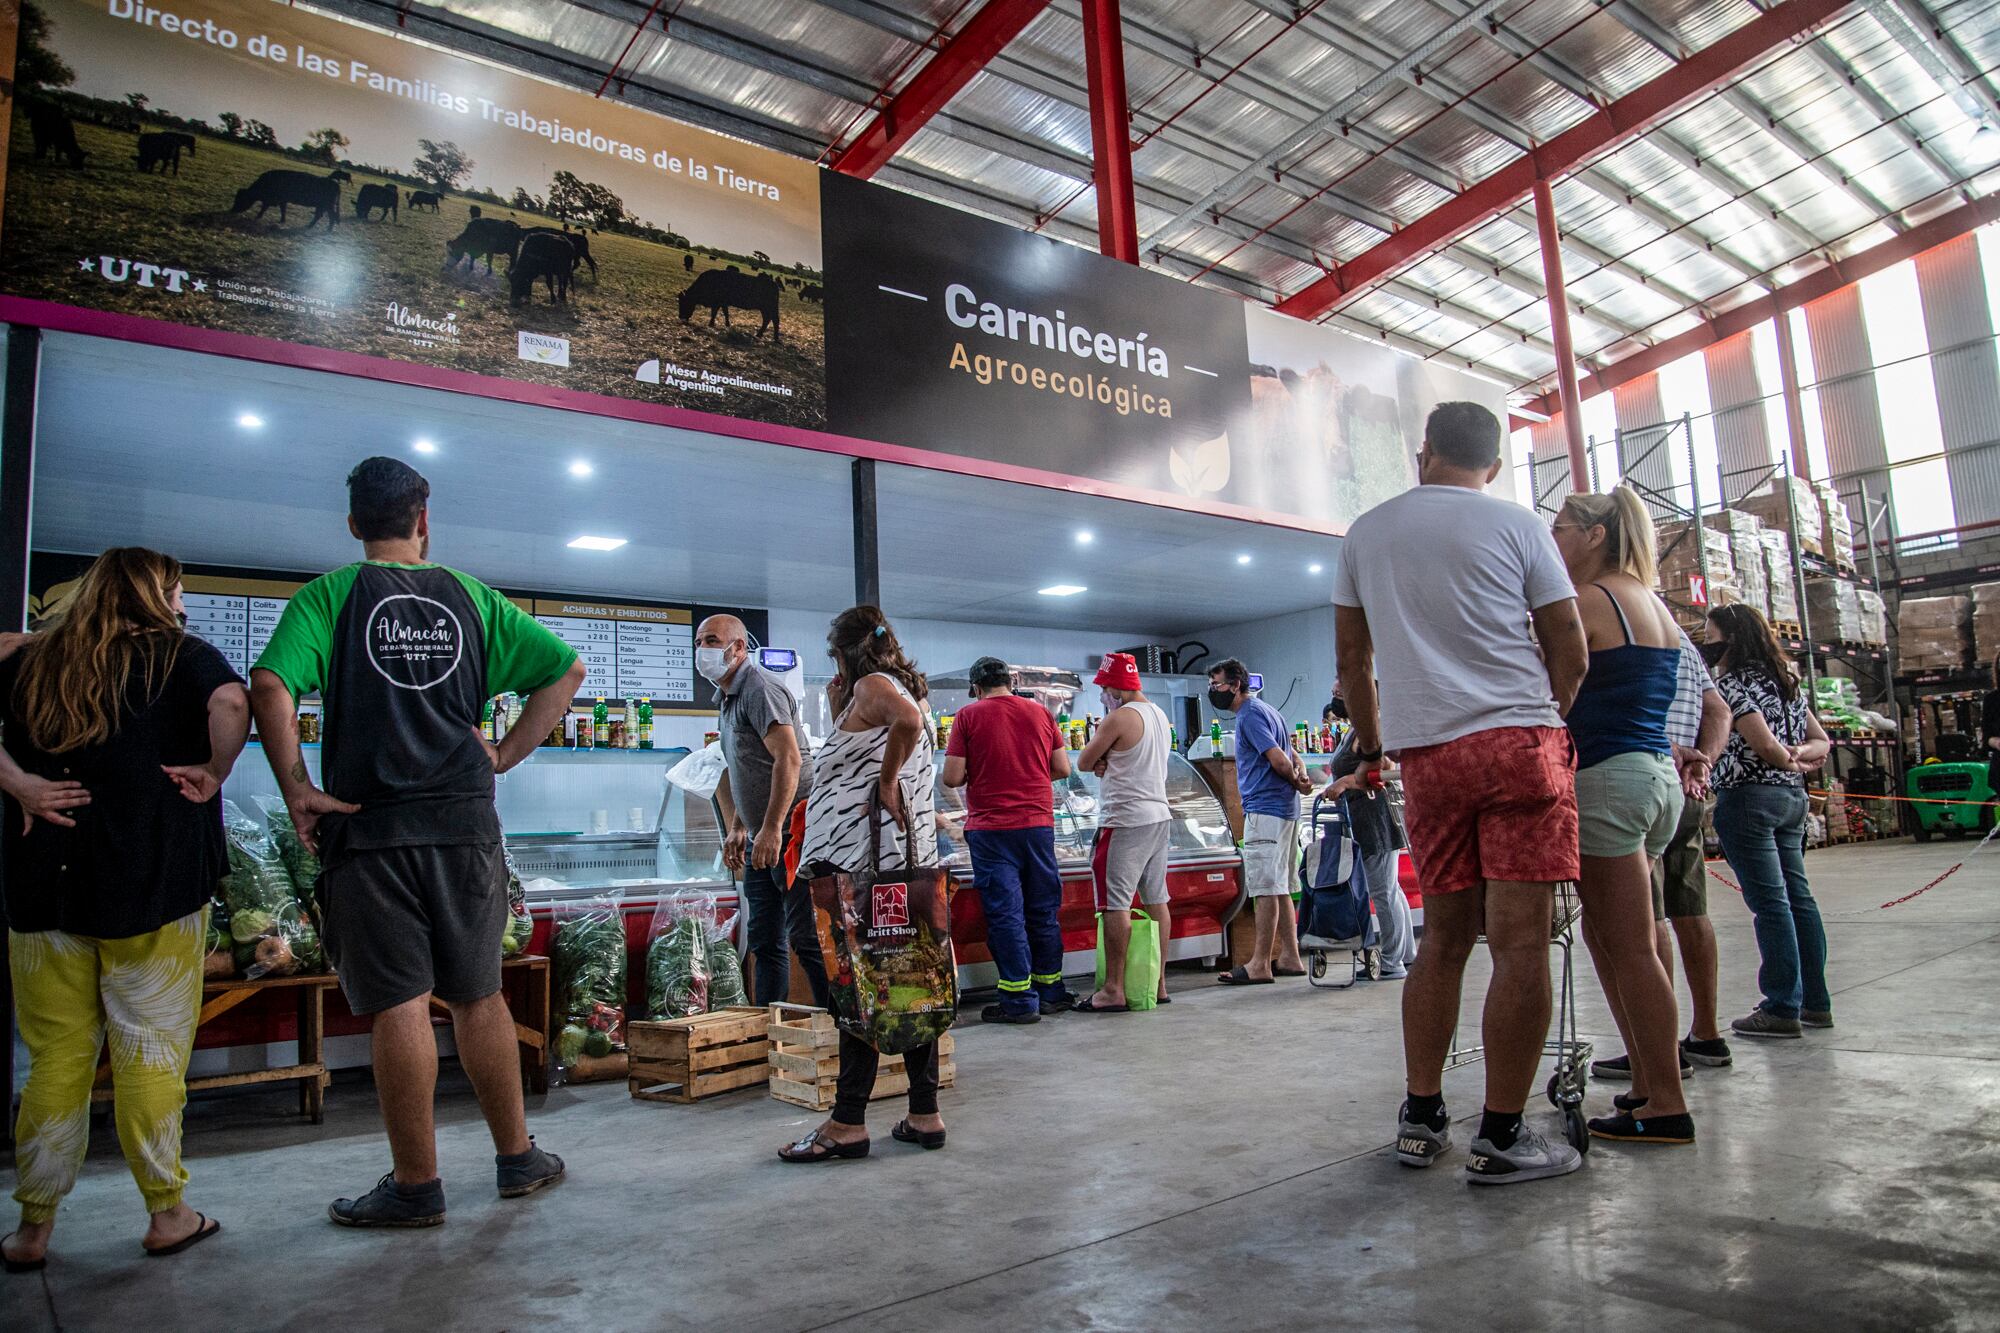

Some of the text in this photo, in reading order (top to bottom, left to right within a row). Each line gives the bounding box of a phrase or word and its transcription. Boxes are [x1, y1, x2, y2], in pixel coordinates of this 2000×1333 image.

[109, 0, 780, 201] Directo de las Familias Trabajadoras de la Tierra
[99, 255, 190, 293] UTT
[217, 279, 247, 291] Unión
[249, 285, 262, 295] de
[266, 287, 327, 307] Trabajadores
[217, 290, 336, 319] Trabajadoras de la Tierra
[944, 283, 1170, 379] Carnicería
[523, 335, 563, 351] RENAMA
[665, 362, 792, 397] Mesa Agroalimentaria
[948, 342, 1172, 420] Agroecológica
[665, 376, 725, 396] Argentina
[1689, 577, 1706, 603] K
[226, 600, 244, 608] 830
[253, 601, 277, 609] Colita
[225, 612, 243, 620] 810
[253, 614, 276, 622] Lomo
[562, 605, 668, 619] ACHURAS Y EMBUTIDOS
[225, 625, 243, 633] 780
[620, 624, 653, 633] Mondongo
[414, 644, 454, 652] GENERALES
[406, 653, 427, 661] UTT
[620, 657, 643, 665] Lengua
[620, 668, 636, 676] Seso
[620, 680, 642, 688] Molleja
[867, 926, 918, 938] Britt Shop
[921, 1003, 932, 1013] 80
[1398, 1137, 1428, 1155] NIKE
